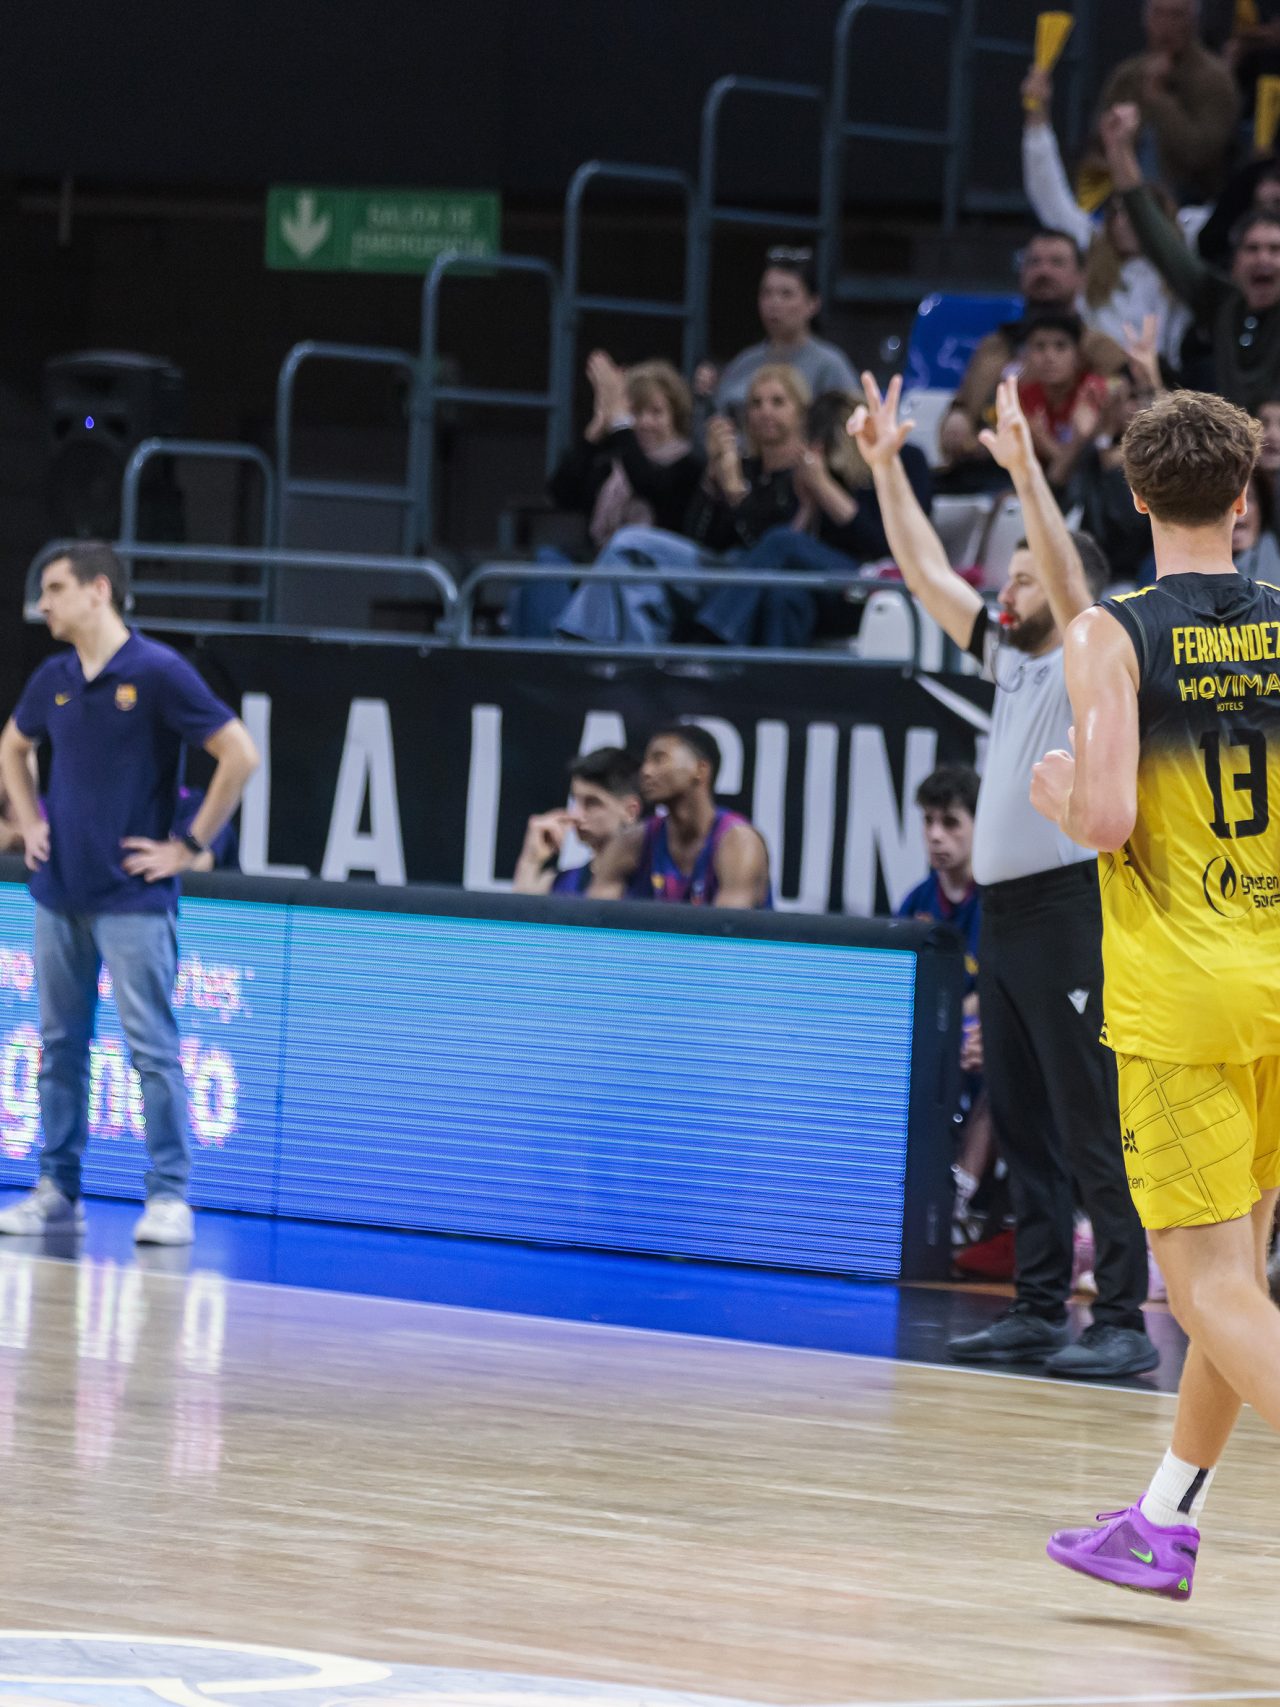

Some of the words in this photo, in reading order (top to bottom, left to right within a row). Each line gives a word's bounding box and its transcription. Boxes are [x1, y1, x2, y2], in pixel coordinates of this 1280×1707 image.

[1216, 701, 1244, 712] HOTELS
[239, 691, 407, 886] LA
[1199, 728, 1270, 839] 13
